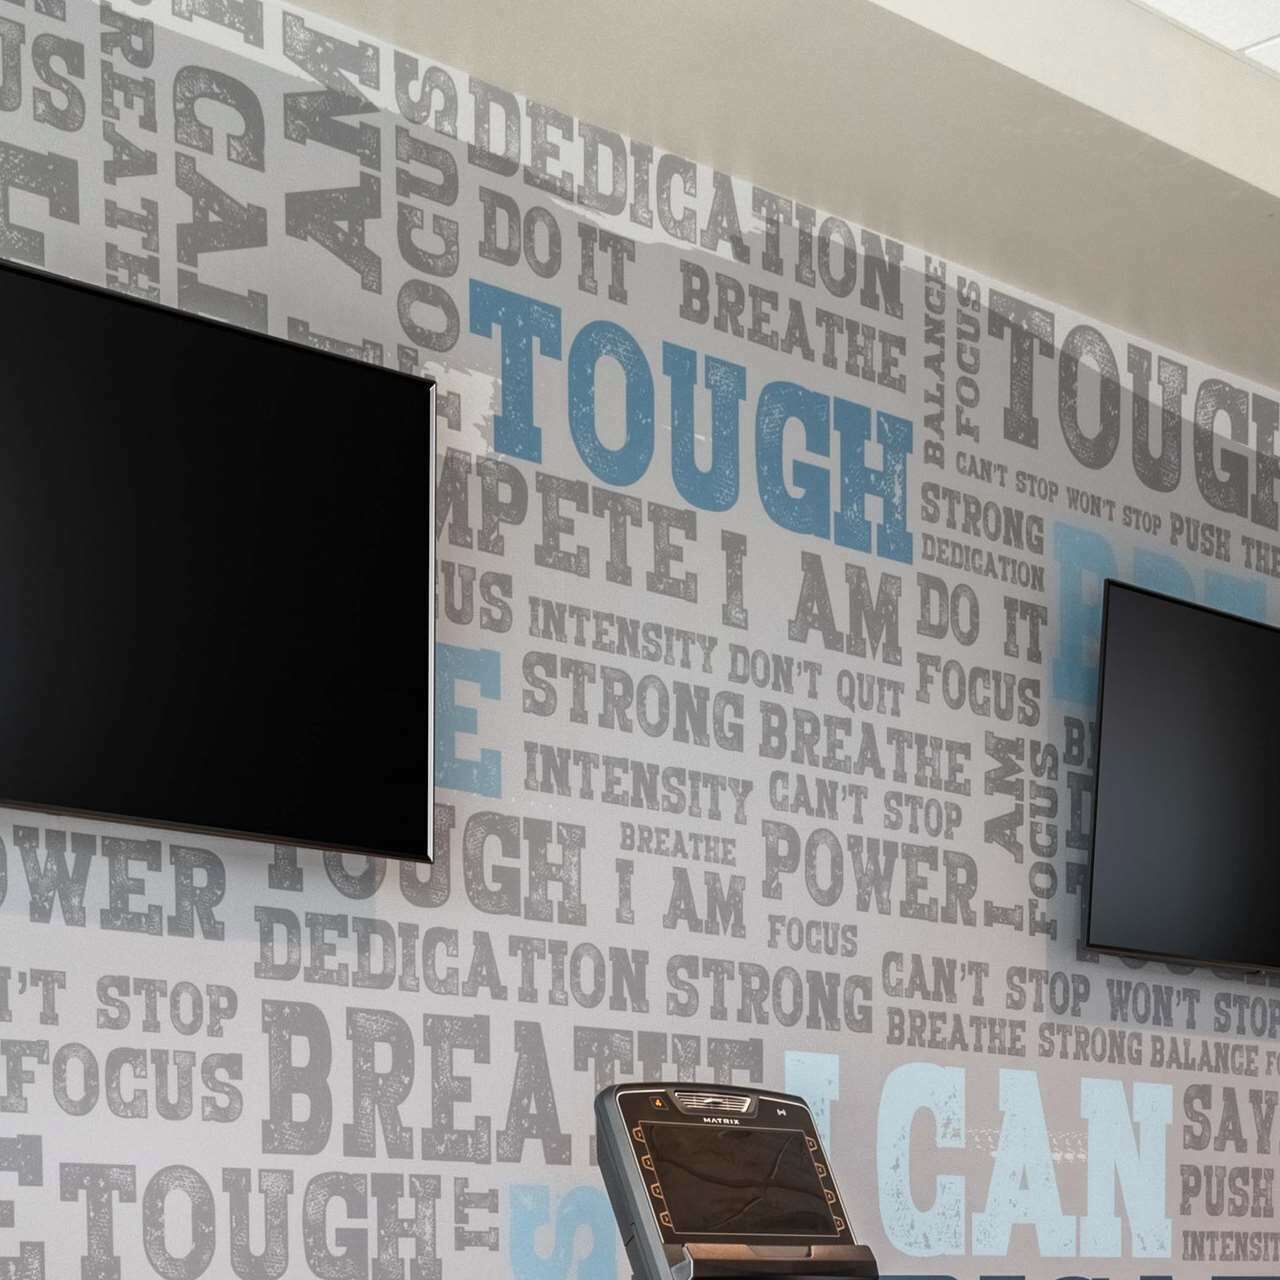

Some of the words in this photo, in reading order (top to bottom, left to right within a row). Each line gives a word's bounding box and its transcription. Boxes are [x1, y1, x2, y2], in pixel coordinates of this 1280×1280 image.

[282, 10, 383, 295] AM
[468, 75, 906, 320] DEDICATION
[479, 186, 562, 279] DO
[577, 221, 635, 304] IT
[680, 258, 907, 394] BREATHE
[923, 255, 946, 470] BALANCE
[955, 275, 981, 444] FOCUS
[468, 278, 914, 565] TOUGH
[920, 482, 1045, 556] STRONG
[956, 450, 1008, 490] CAN'T
[1015, 470, 1059, 504] STOP
[1066, 485, 1116, 521] WON'T
[1122, 505, 1162, 537] STOP
[1169, 512, 1231, 563] PUSH
[721, 529, 748, 630] I
[787, 550, 903, 666] AM
[921, 533, 1045, 593] DEDICATION
[528, 596, 718, 674] INTENSITY
[728, 643, 823, 699] DON'T
[837, 669, 905, 717] QUIT
[917, 573, 980, 648] DO
[1003, 595, 1048, 664] IT
[522, 650, 745, 753] STRONG
[759, 701, 972, 797] BREATHE
[916, 652, 1041, 727] FOCUS
[524, 740, 753, 825] INTENSITY
[769, 770, 869, 825] CAN'T
[884, 790, 962, 842] STOP
[621, 821, 737, 867] BREATHE
[984, 730, 1025, 865] AM
[1028, 739, 1059, 941] FOCUS
[616, 858, 635, 925] I
[663, 867, 748, 939] AM
[761, 819, 978, 926] POWER
[984, 897, 1024, 932] I
[253, 905, 650, 1014] DEDICATION
[666, 953, 874, 1034] STRONG
[767, 914, 858, 958] FOCUS
[96, 976, 238, 1038] STOP
[882, 951, 989, 1012] CAN'T
[1006, 966, 1091, 1018] STOP
[1106, 978, 1200, 1029] WON'T
[887, 1006, 1026, 1058] BREATHE
[1039, 1022, 1142, 1067] STRONG
[1150, 1034, 1259, 1078] BALANCE
[0, 1038, 243, 1123] FOCUS
[703, 1117, 740, 1125] MATRIX
[455, 1176, 500, 1252] IT
[877, 1062, 1174, 1260] CAN
[1179, 1164, 1274, 1218] PUSH
